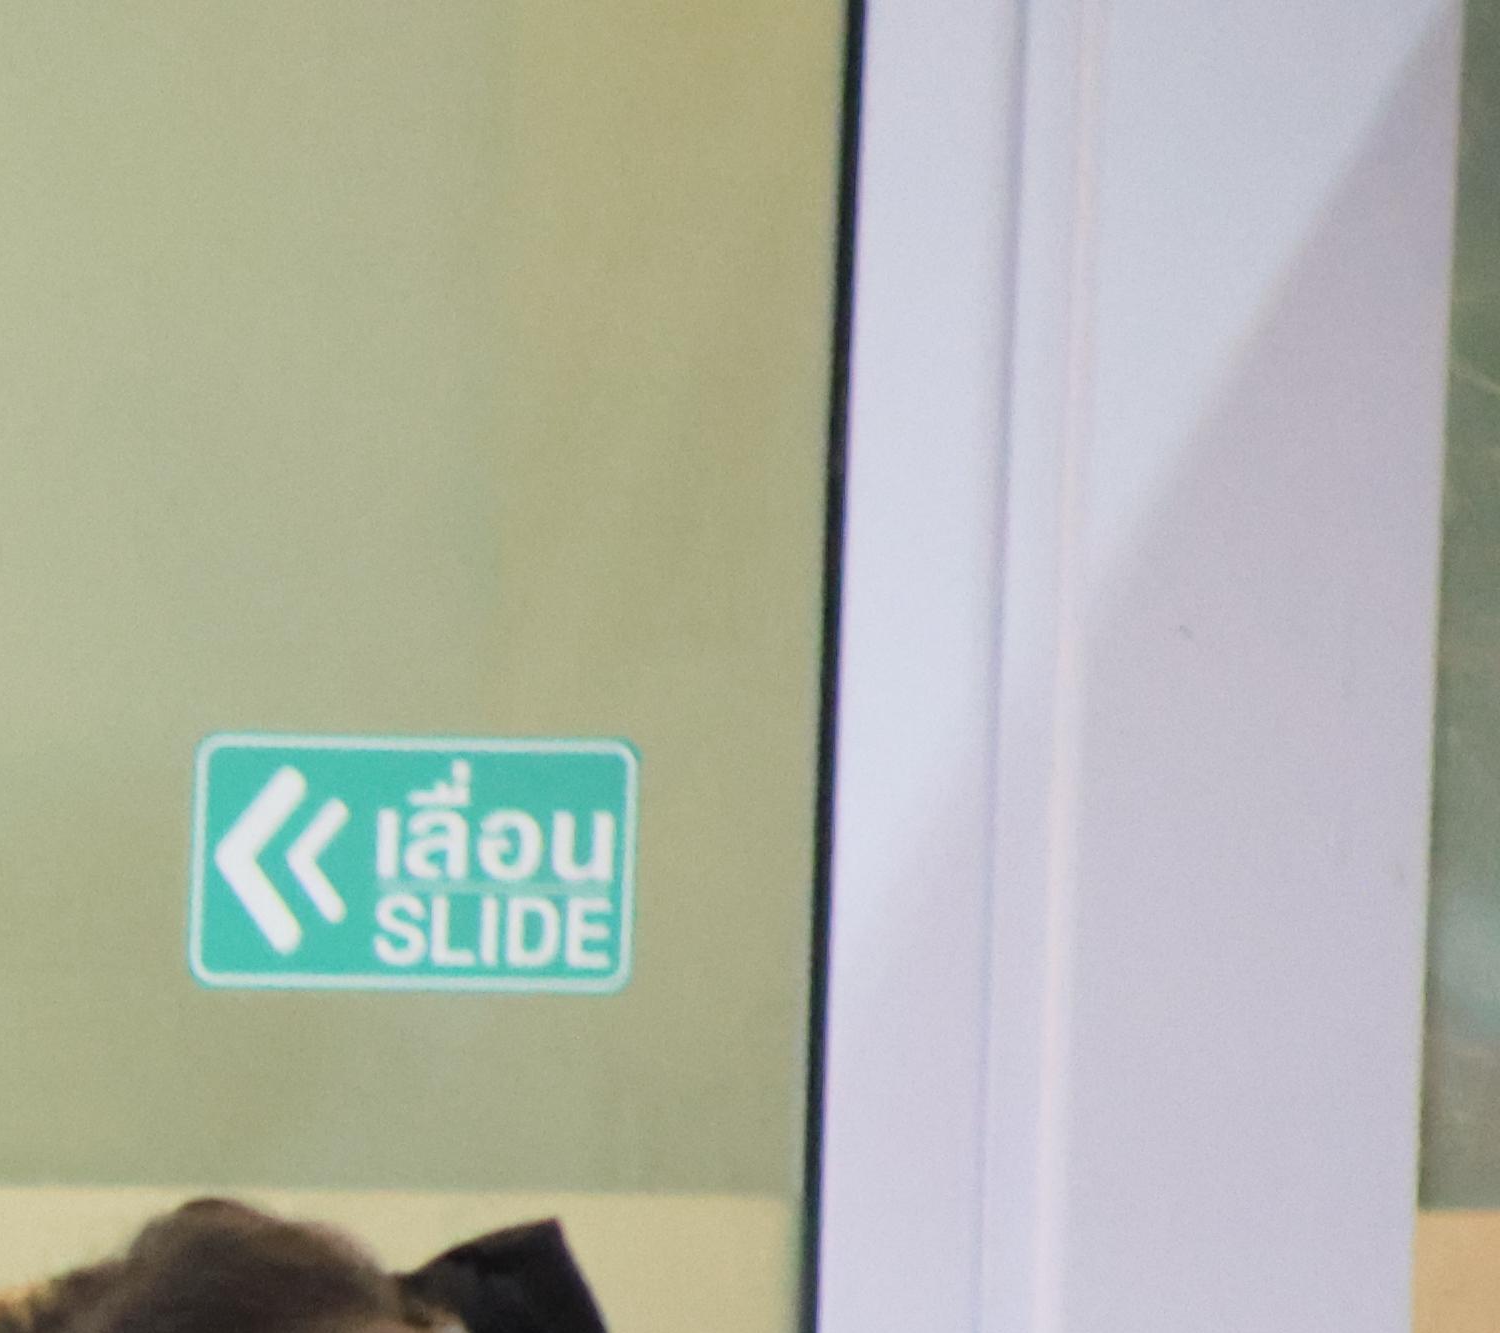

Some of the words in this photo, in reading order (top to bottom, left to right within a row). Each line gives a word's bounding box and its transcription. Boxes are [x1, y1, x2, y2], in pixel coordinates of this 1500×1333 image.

[374, 758, 616, 881] เลื่อน
[372, 893, 612, 969] SLIDE
